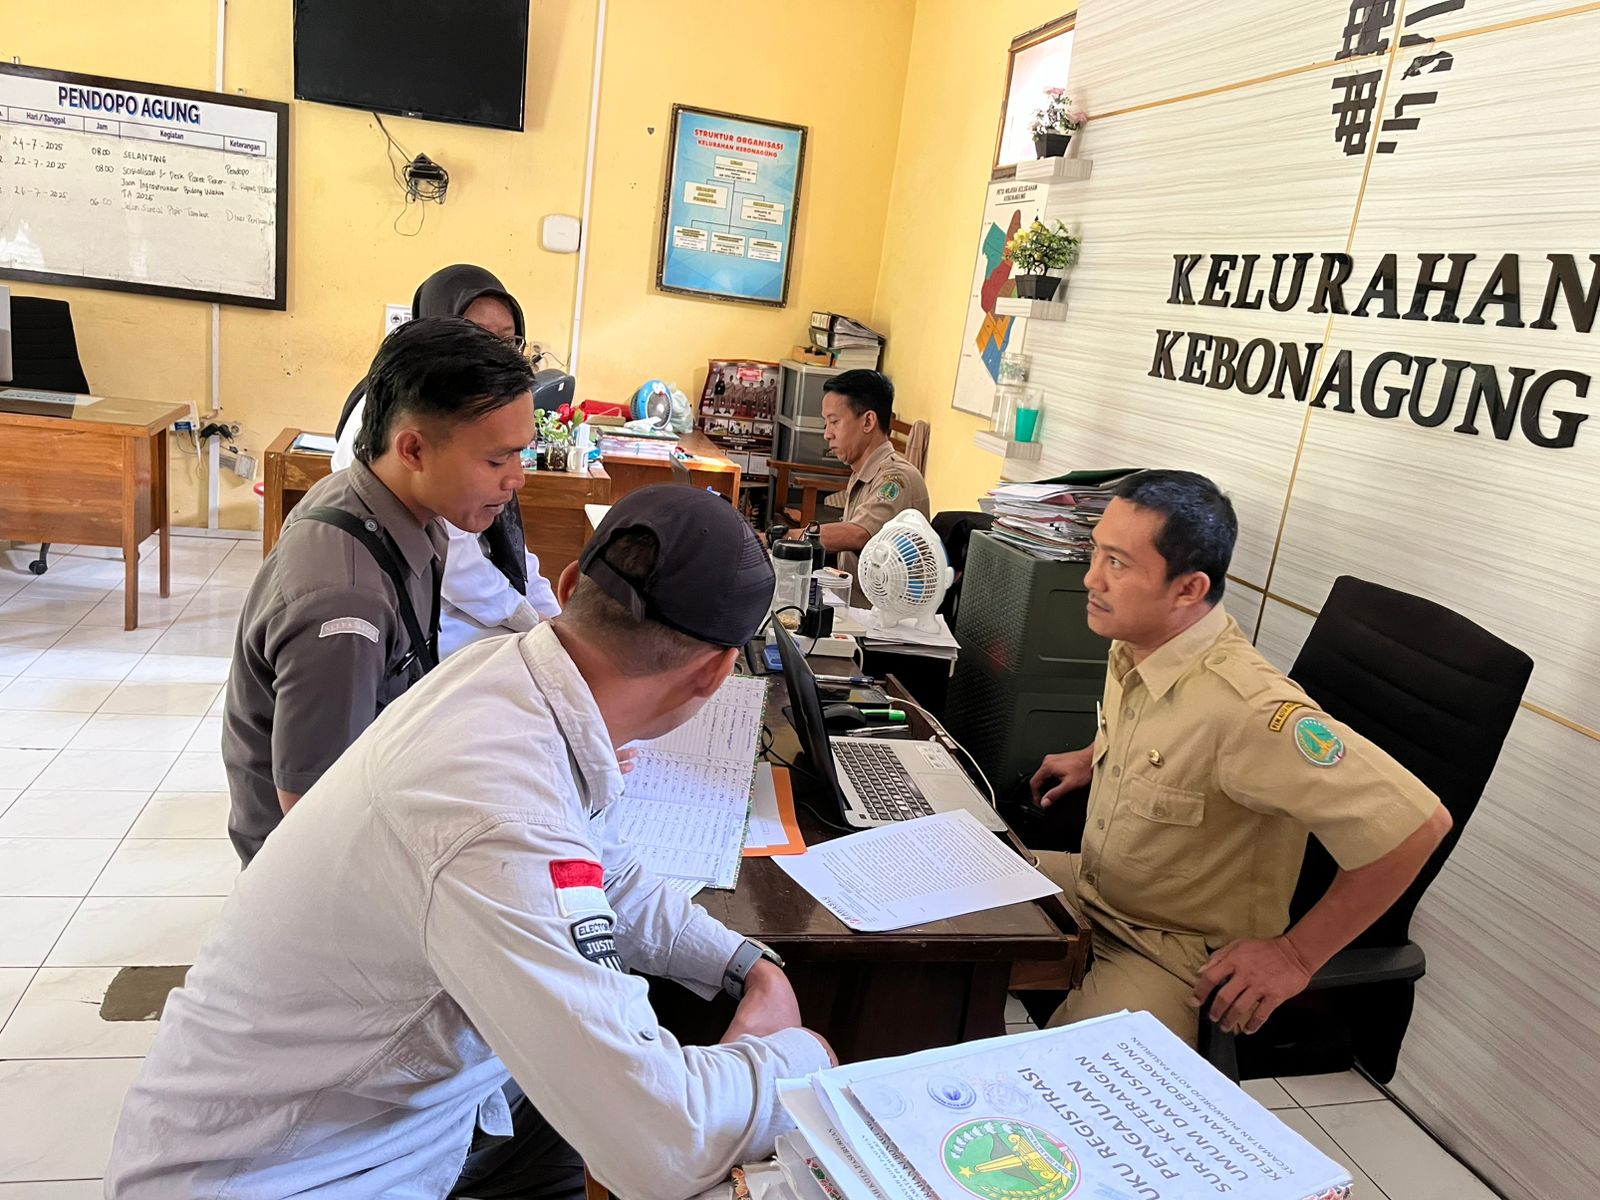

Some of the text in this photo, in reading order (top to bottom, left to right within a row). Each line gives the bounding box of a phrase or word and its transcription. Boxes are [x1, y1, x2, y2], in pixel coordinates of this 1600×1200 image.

[26, 112, 39, 121] Hari
[44, 114, 66, 125] Tanggal
[58, 86, 201, 125] PENDOPO AGUNG
[160, 130, 184, 140] Kegiatan
[230, 140, 260, 151] Keterangan
[694, 128, 784, 150] STRUKTUR ORGANISASI
[698, 140, 777, 157] KELURAHAN KEBONAGUNG
[1166, 253, 1600, 333] KELURAHAN
[1148, 329, 1591, 449] KEBONAGUNG
[1170, 1071, 1192, 1088] KOTA
[1017, 1067, 1117, 1159] REGISTRASI
[1067, 1080, 1180, 1179] PENGAJUAN
[1075, 1056, 1232, 1193] SURAT KETERANGAN
[1101, 1052, 1249, 1181] UMUM DAN USAHA
[1116, 1042, 1282, 1181] KELURAHAN KEBONAGUNG
[1240, 1131, 1295, 1175] KECAMATAN
